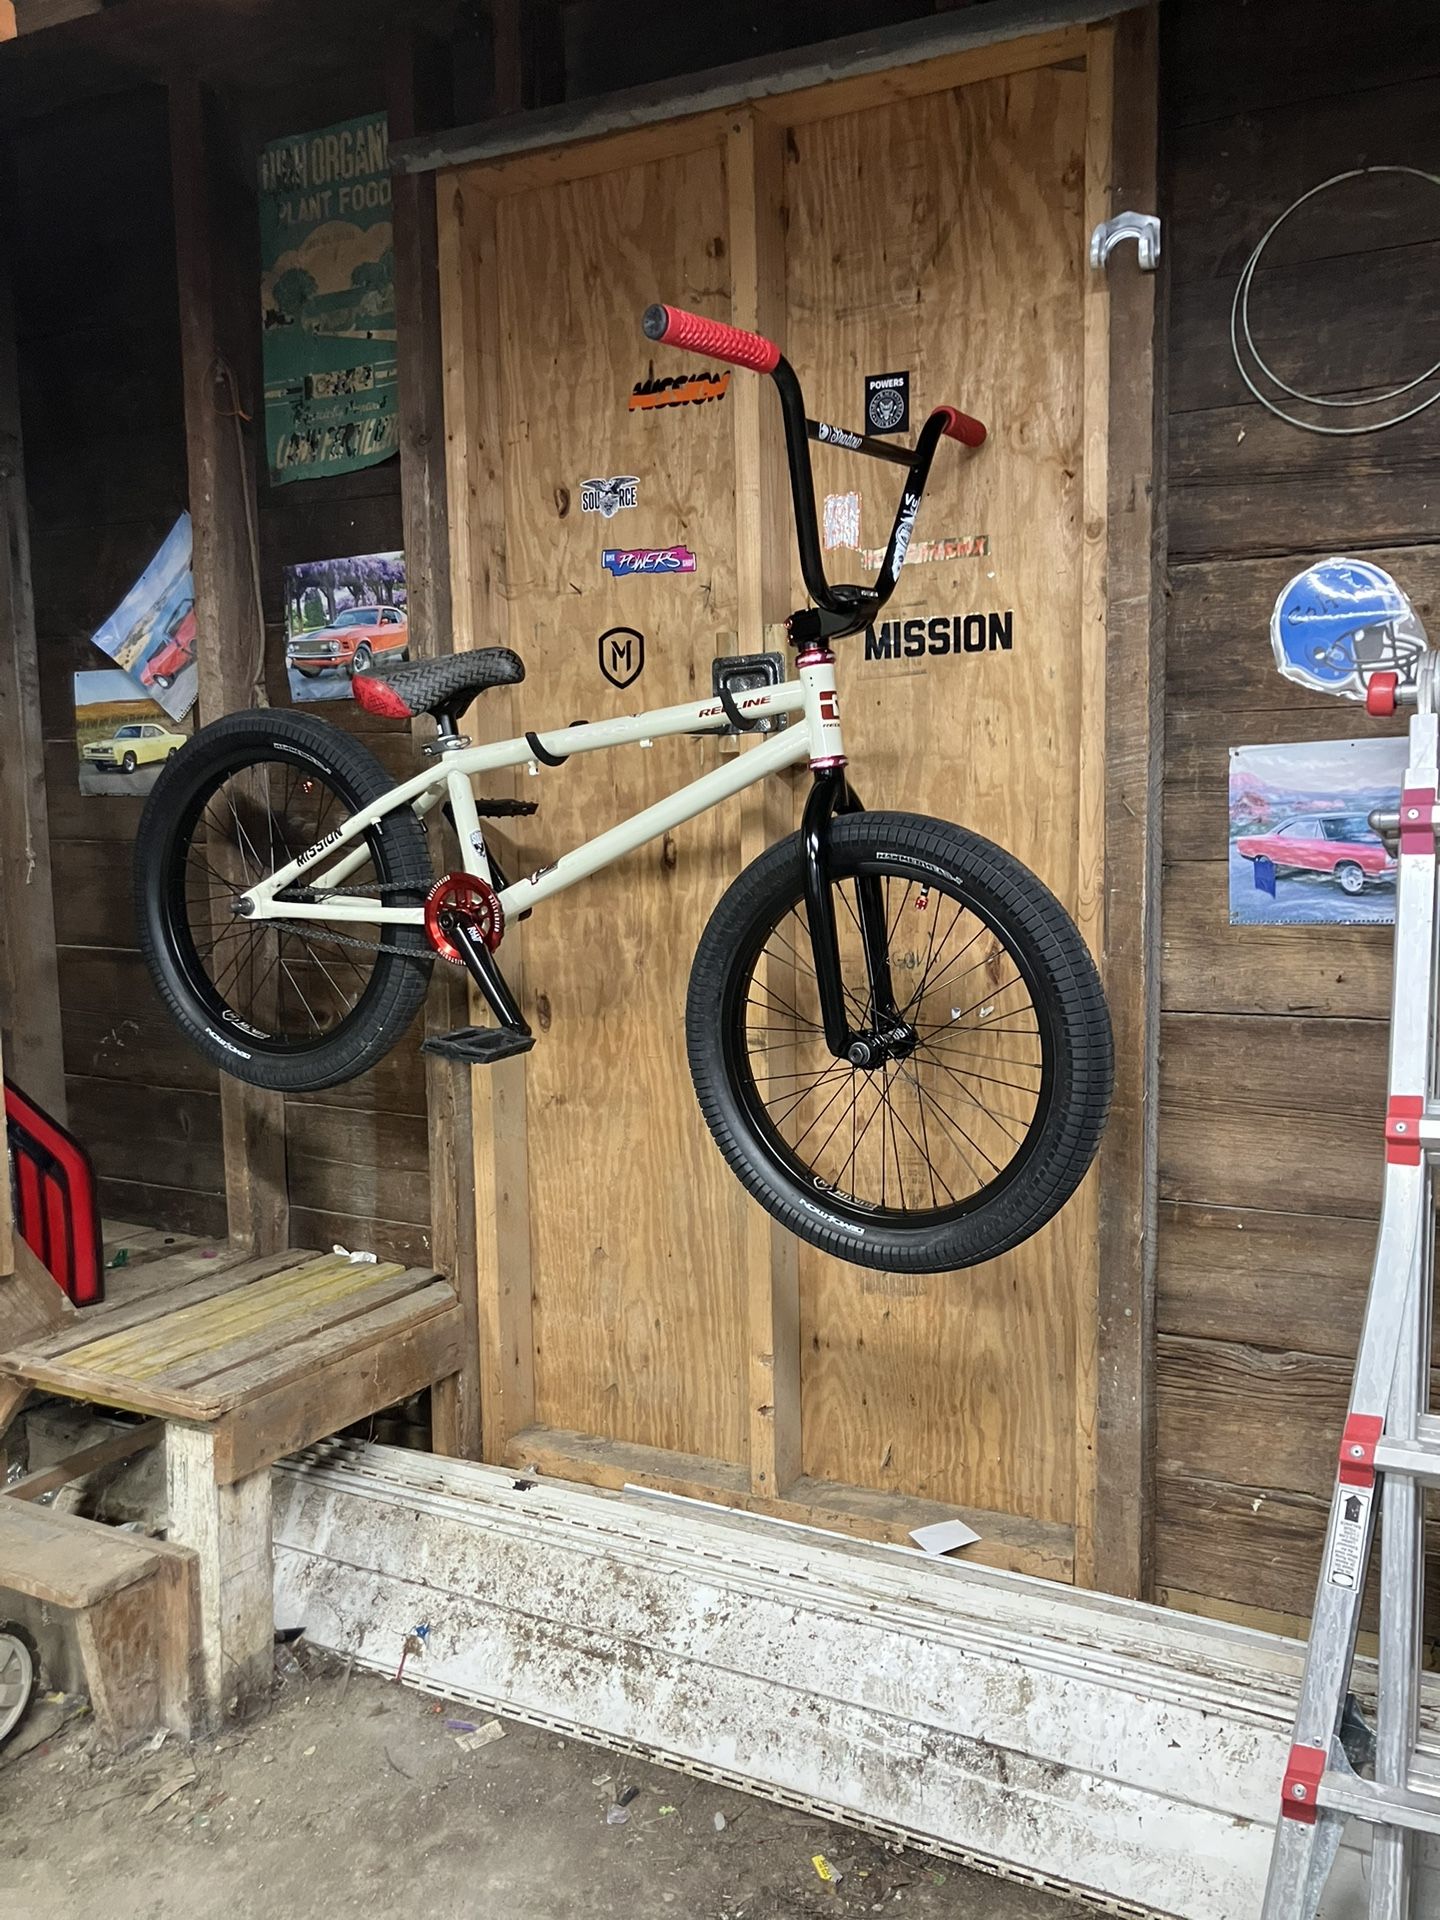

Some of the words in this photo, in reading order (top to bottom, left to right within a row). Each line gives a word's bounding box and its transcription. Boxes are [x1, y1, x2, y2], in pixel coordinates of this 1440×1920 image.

[628, 370, 731, 412] MISSION
[870, 377, 904, 390] POWERS
[618, 551, 681, 571] POWERS
[864, 611, 1014, 661] MISSION
[698, 694, 772, 719] REINE
[297, 827, 344, 868] MISSION
